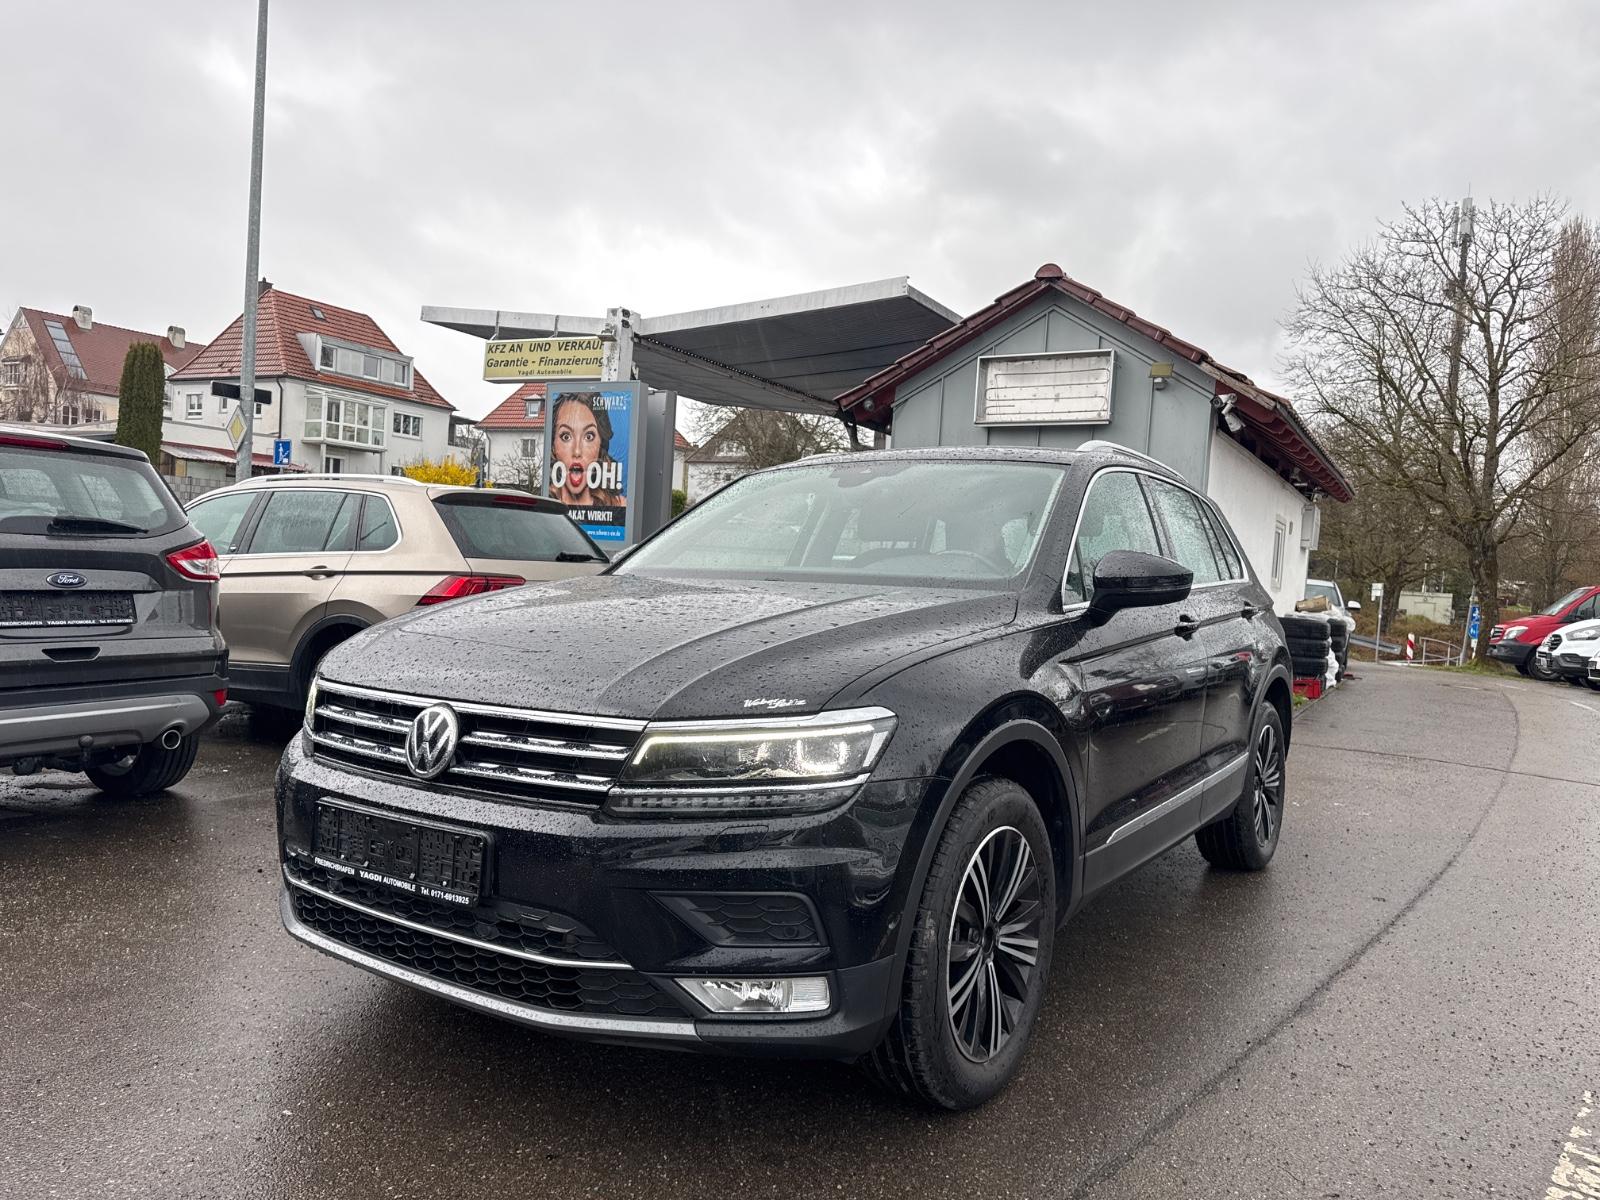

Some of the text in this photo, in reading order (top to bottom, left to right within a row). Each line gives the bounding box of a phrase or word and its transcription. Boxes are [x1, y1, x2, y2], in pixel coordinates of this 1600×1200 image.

[488, 344, 506, 353] KFZ
[509, 343, 523, 353] AN
[529, 342, 551, 352] UND
[486, 358, 529, 368] Garantie
[587, 510, 613, 521] WIRKT!
[57, 574, 80, 584] Ford
[359, 870, 382, 882] YAGDI
[382, 876, 416, 892] AUTOMOBILE
[420, 886, 429, 896] Tel.
